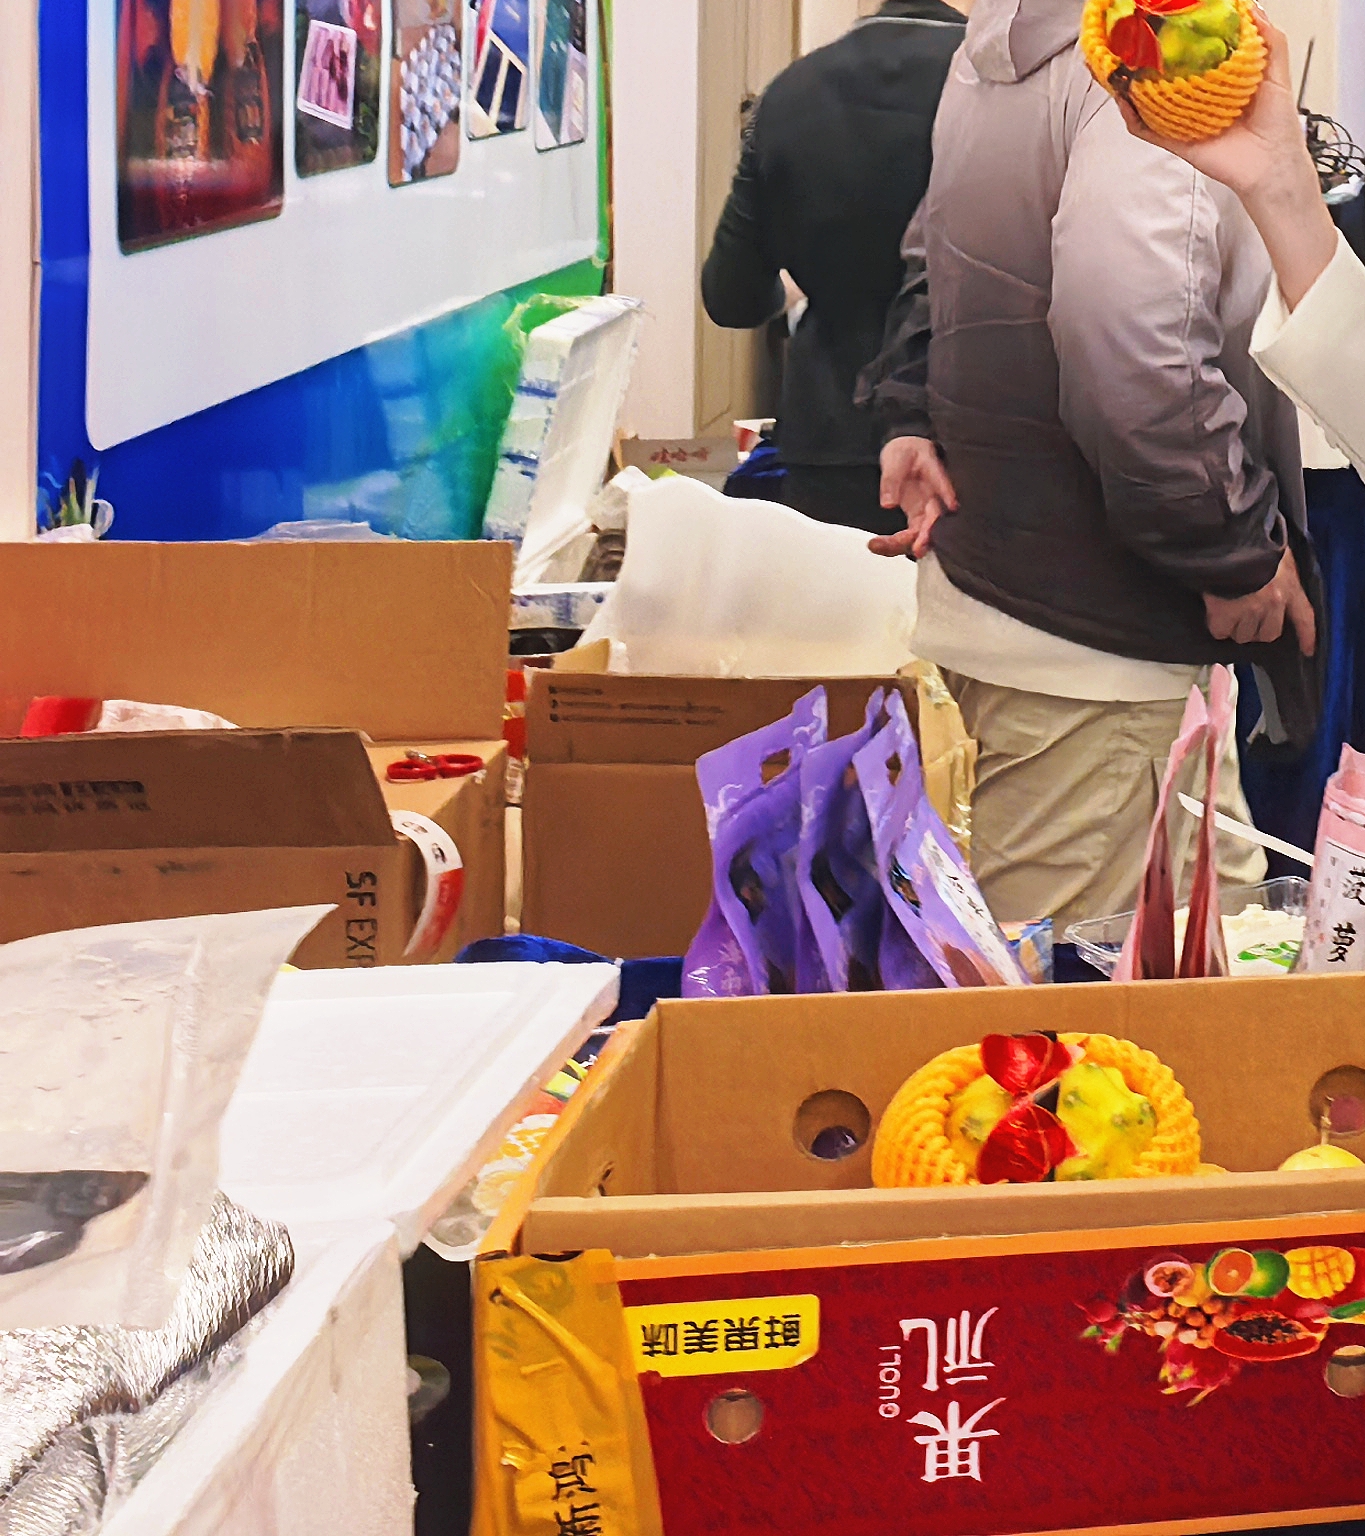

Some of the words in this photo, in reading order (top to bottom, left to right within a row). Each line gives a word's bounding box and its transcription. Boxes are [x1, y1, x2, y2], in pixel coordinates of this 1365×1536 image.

[345, 871, 378, 907] SF
[641, 1313, 802, 1357] 鲜果美味
[879, 1345, 902, 1419] GUOLI
[898, 1306, 1007, 1482] 果礼
